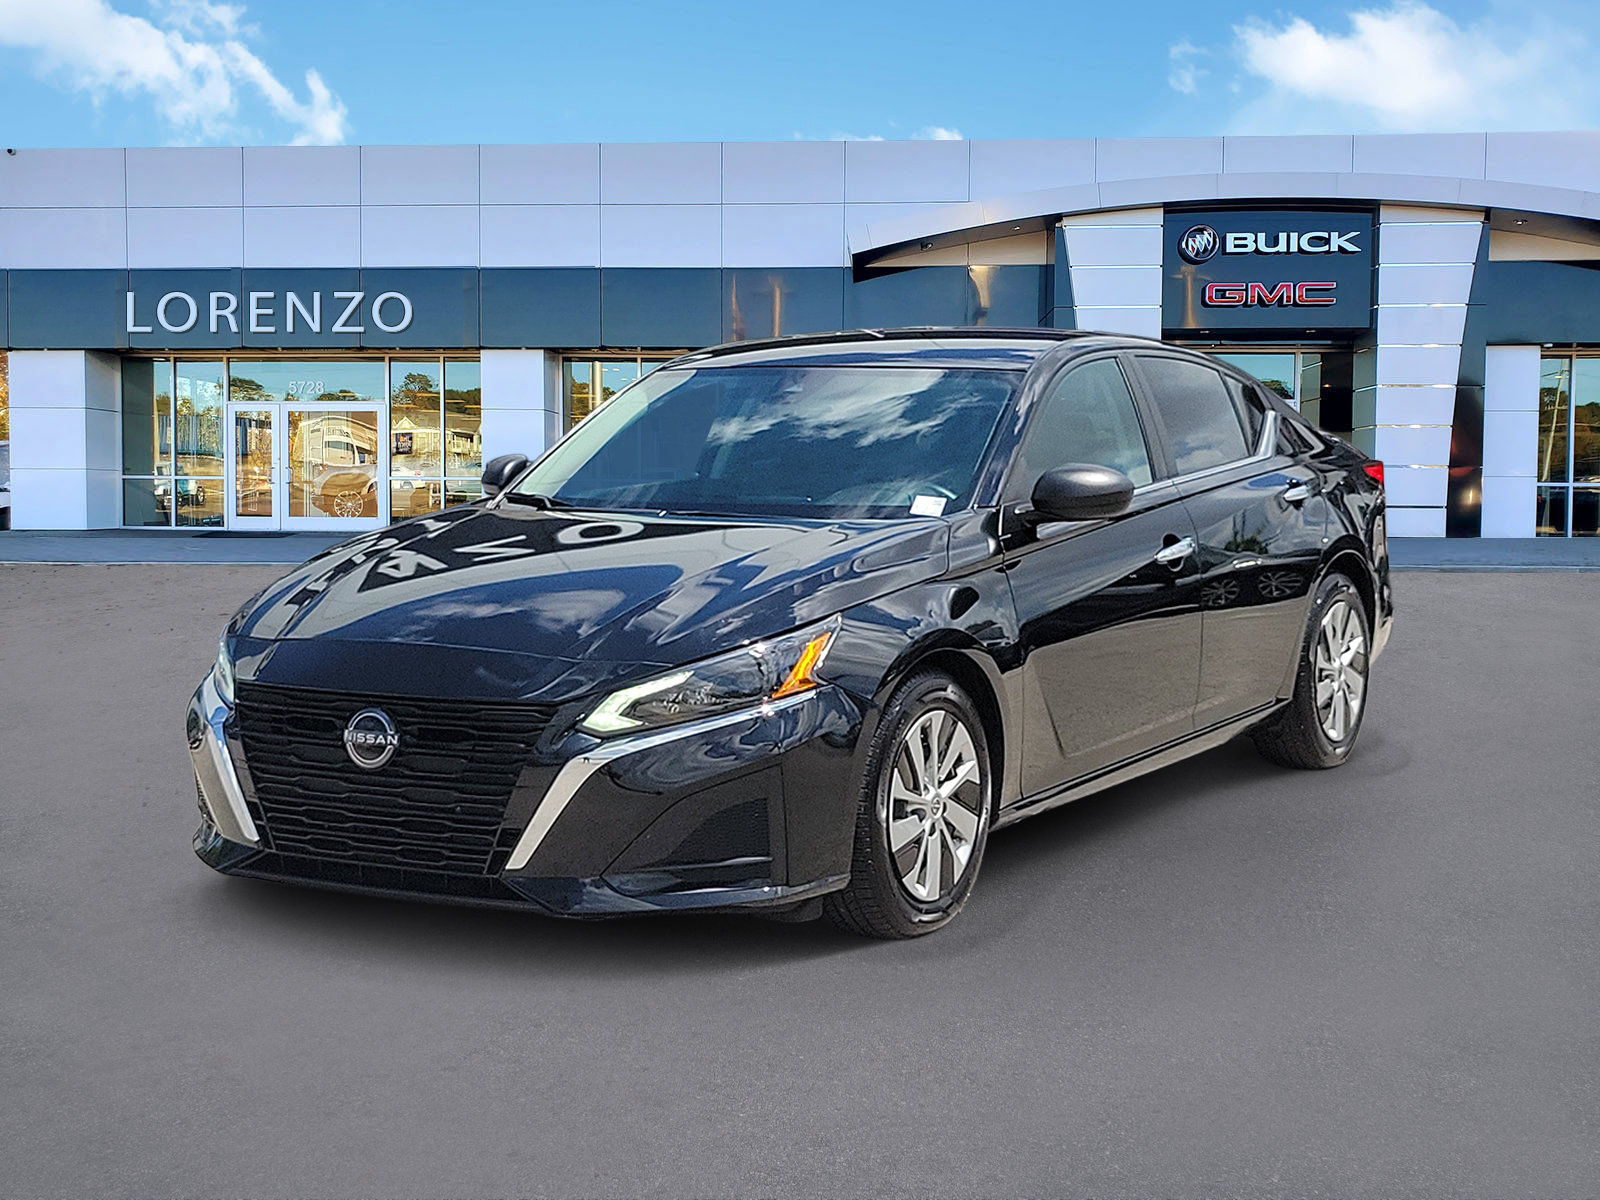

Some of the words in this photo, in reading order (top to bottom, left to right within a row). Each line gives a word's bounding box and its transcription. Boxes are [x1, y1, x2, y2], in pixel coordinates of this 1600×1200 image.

[1225, 231, 1362, 254] BUICK
[1204, 281, 1337, 306] GMC
[126, 291, 414, 333] LORENZO
[288, 380, 325, 394] 5728
[344, 730, 399, 745] NISSAN
